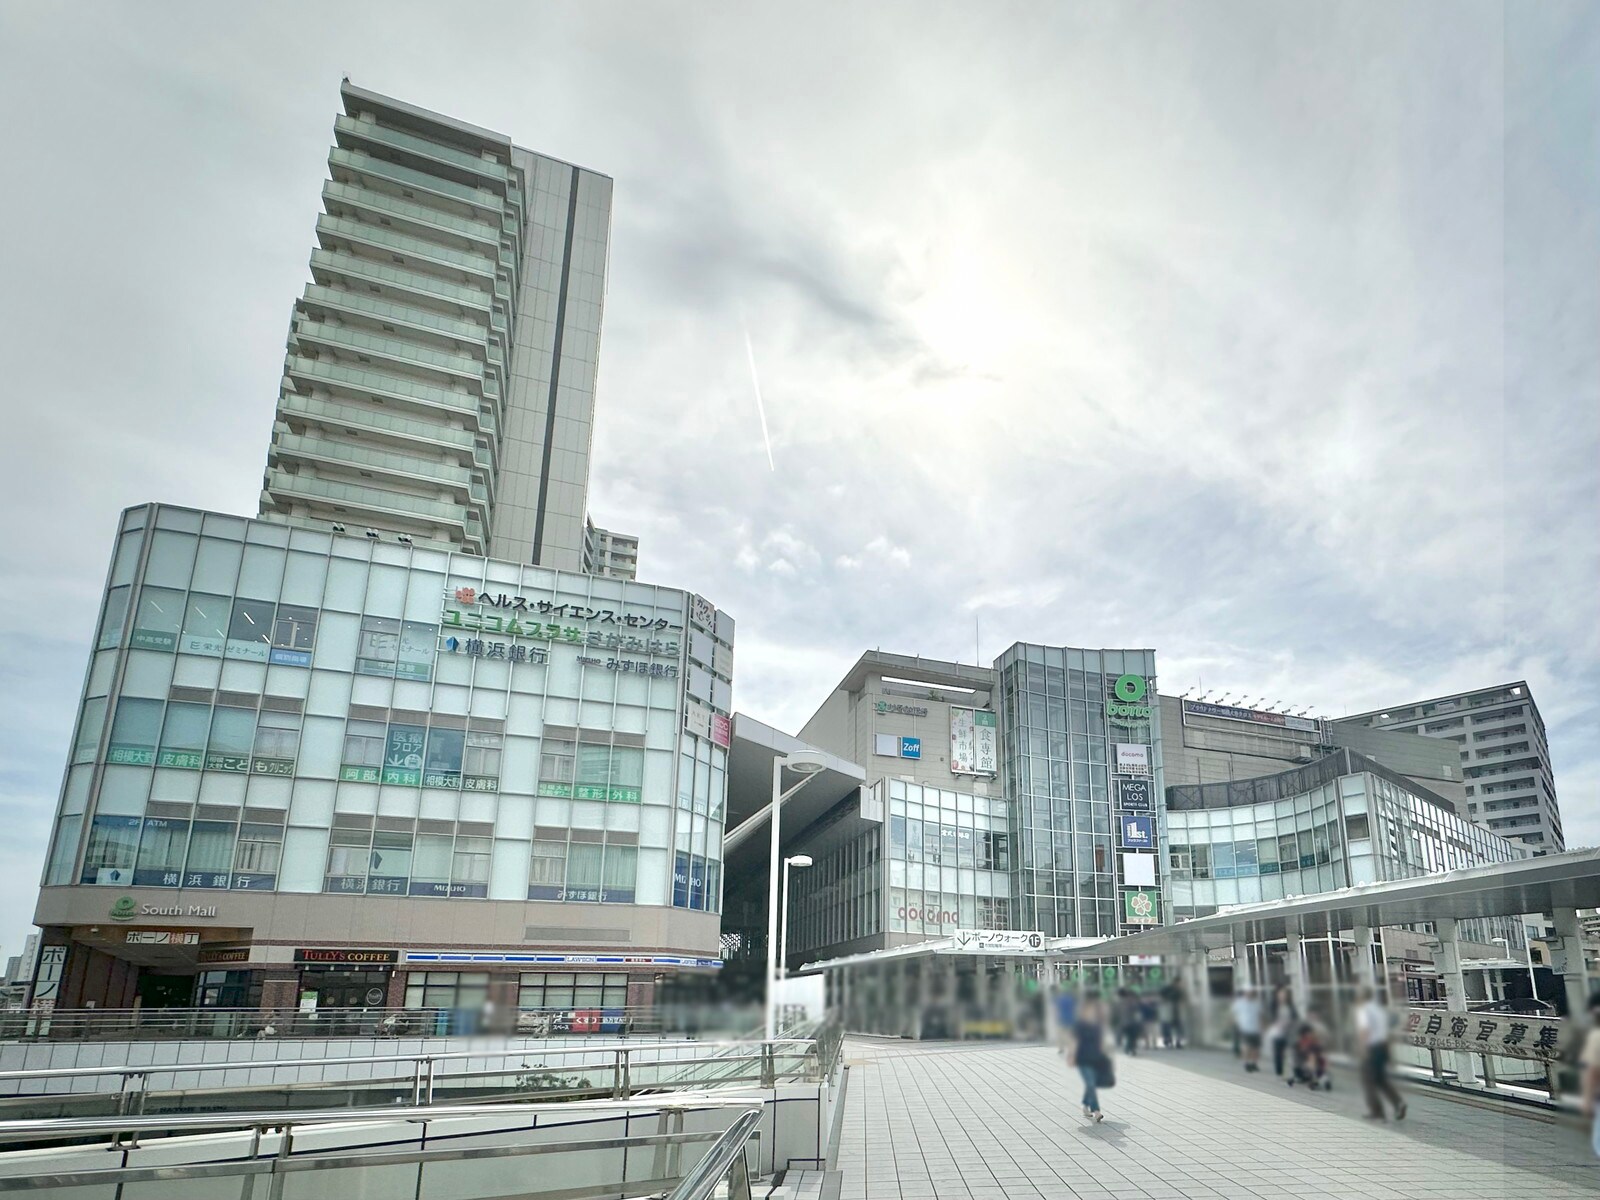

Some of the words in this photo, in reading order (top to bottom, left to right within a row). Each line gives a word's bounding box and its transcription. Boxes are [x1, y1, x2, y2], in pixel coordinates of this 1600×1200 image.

[478, 592, 683, 631] ヘルス・サイエンス・センター
[465, 637, 548, 664] 横浜銀行
[606, 657, 679, 678] みずほ銀行
[1107, 699, 1152, 717] bono
[393, 731, 423, 744] 医療
[393, 742, 423, 753] フロア
[903, 743, 920, 752] Zoff
[980, 728, 993, 769] 食専館
[1122, 784, 1147, 792] MEGA
[1127, 792, 1144, 801] LOS
[147, 819, 168, 827] ATM
[163, 873, 251, 888] 横浜銀行
[341, 878, 400, 892] 横浜銀行
[675, 873, 702, 887] MIZHO
[557, 890, 607, 901] みずほ銀行
[141, 903, 183, 916] South
[188, 905, 216, 917] Mall
[127, 931, 199, 944] ボーノ横丁
[971, 931, 1028, 943] ボーノウォーク
[1029, 935, 1041, 948] 1F
[222, 951, 247, 960] COFFEE
[347, 952, 390, 961] COFFEE
[1424, 1013, 1559, 1050] 自衛官募集
